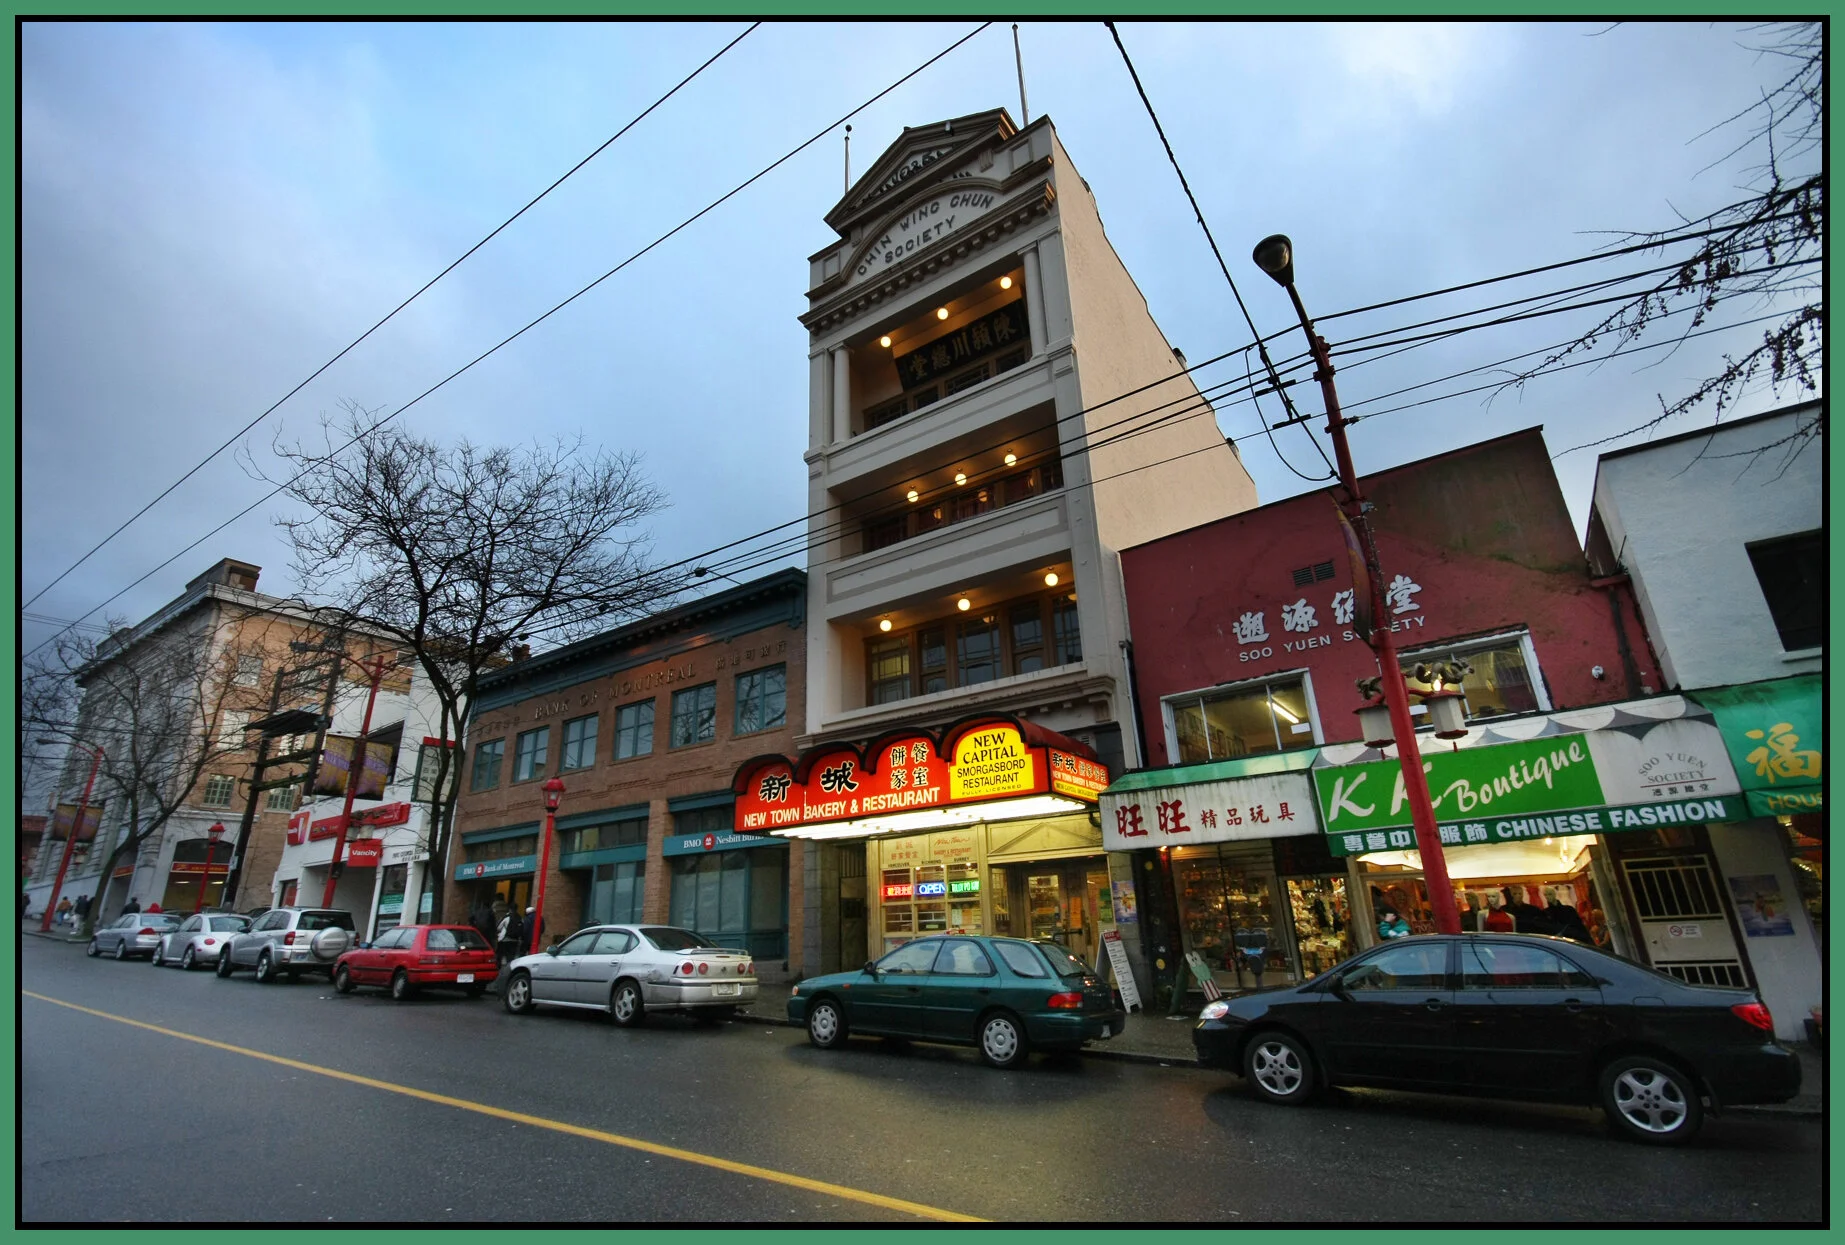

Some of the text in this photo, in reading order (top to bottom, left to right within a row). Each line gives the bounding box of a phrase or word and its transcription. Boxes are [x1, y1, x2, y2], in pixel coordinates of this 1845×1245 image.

[857, 193, 995, 276] CHIN WING CHUN
[884, 214, 956, 264] SOCIETY
[1239, 646, 1273, 662] SOO
[1283, 634, 1332, 653] YUEN
[533, 664, 697, 721] BANK OF MONTREAL
[973, 732, 1007, 749] NEW
[1744, 722, 1822, 785] 福
[957, 759, 1026, 778] SMORGASBORD
[962, 745, 1018, 766] CAPITAL
[1638, 752, 1708, 777] SOO YUEN
[962, 772, 1020, 790] RESTAURANT
[985, 784, 1022, 793] LICENSED
[1328, 771, 1376, 823] K
[1443, 741, 1586, 813] Boutique
[1647, 769, 1705, 784] SOCIETY
[743, 786, 941, 828] NEW TOWN BAKERY & RESTAURANT
[1115, 799, 1296, 839] 旺旺 精品玩具
[1496, 800, 1727, 838] CHINESE FASHION
[683, 838, 702, 849] BMO
[715, 834, 741, 845] Nesbitt
[1343, 823, 1488, 852] 專營中服飾
[351, 849, 378, 858] Vancity
[919, 882, 946, 895] OPEN
